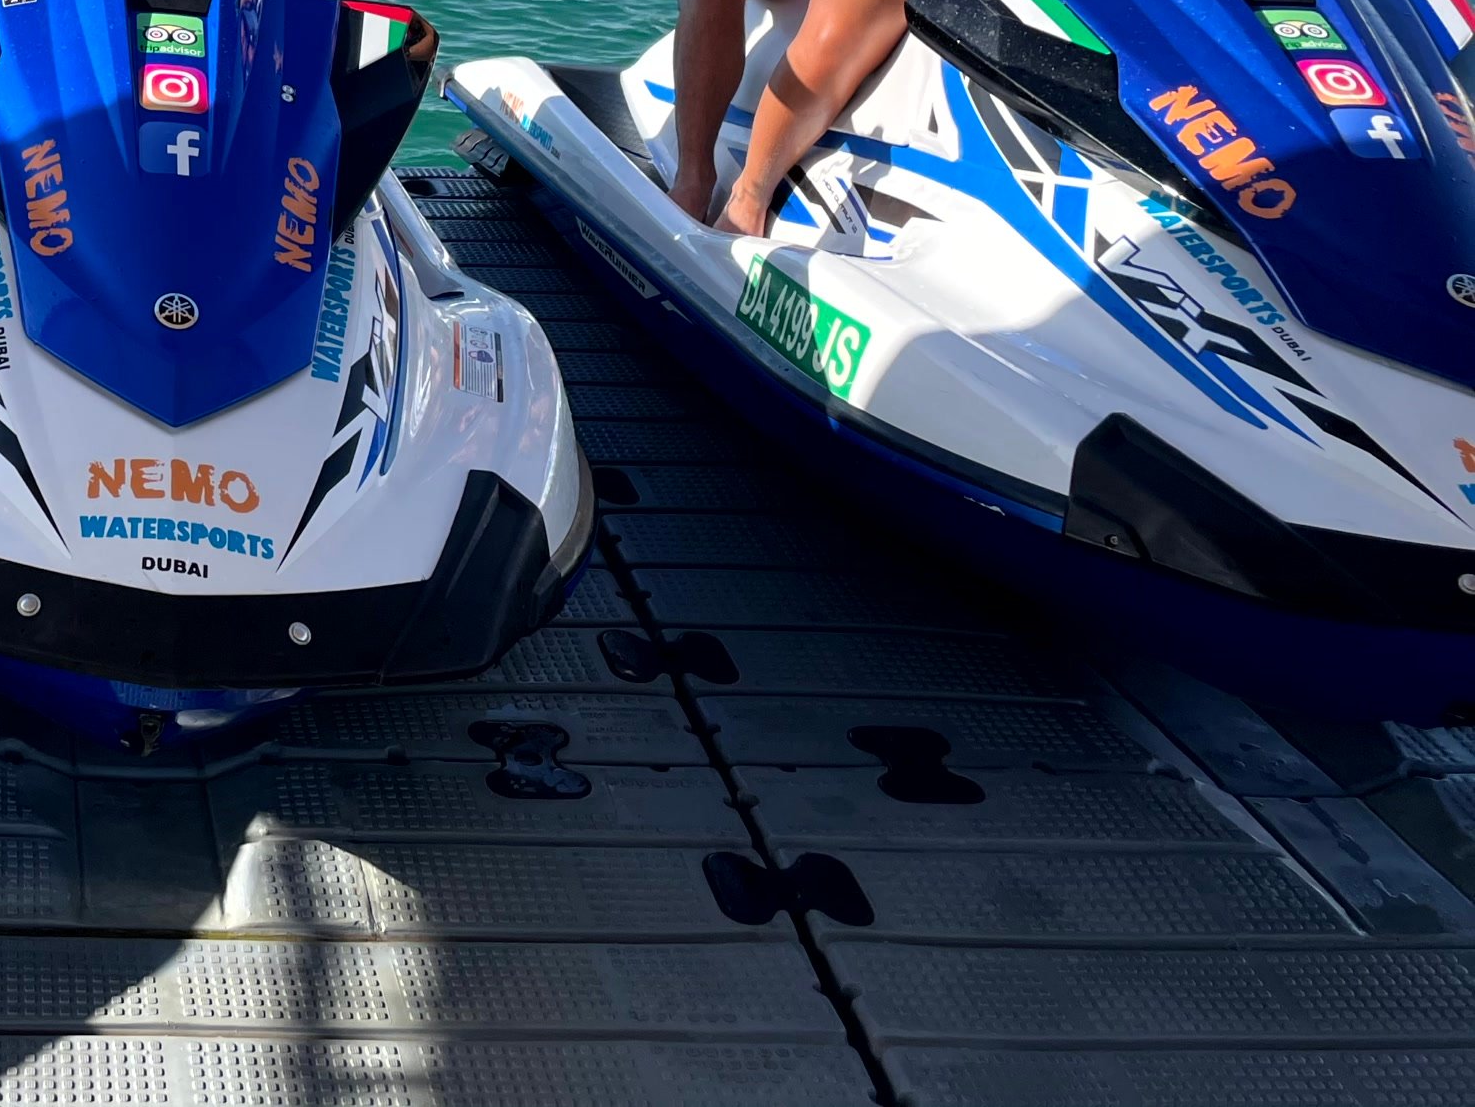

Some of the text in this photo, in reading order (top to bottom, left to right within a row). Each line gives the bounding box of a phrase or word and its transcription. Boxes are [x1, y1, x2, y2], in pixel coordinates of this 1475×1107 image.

[22, 139, 73, 257] NEMO
[1148, 84, 1297, 219] NEMO
[273, 156, 320, 273] NEMO
[311, 243, 356, 383] WATERSPORTS
[740, 261, 861, 387] DA 4199 JS
[1136, 197, 1312, 362] WATERSPORTS DUBAI
[79, 514, 274, 560] WATERSPORTS
[86, 458, 260, 513] NEMO
[141, 556, 209, 579] DUBAI
